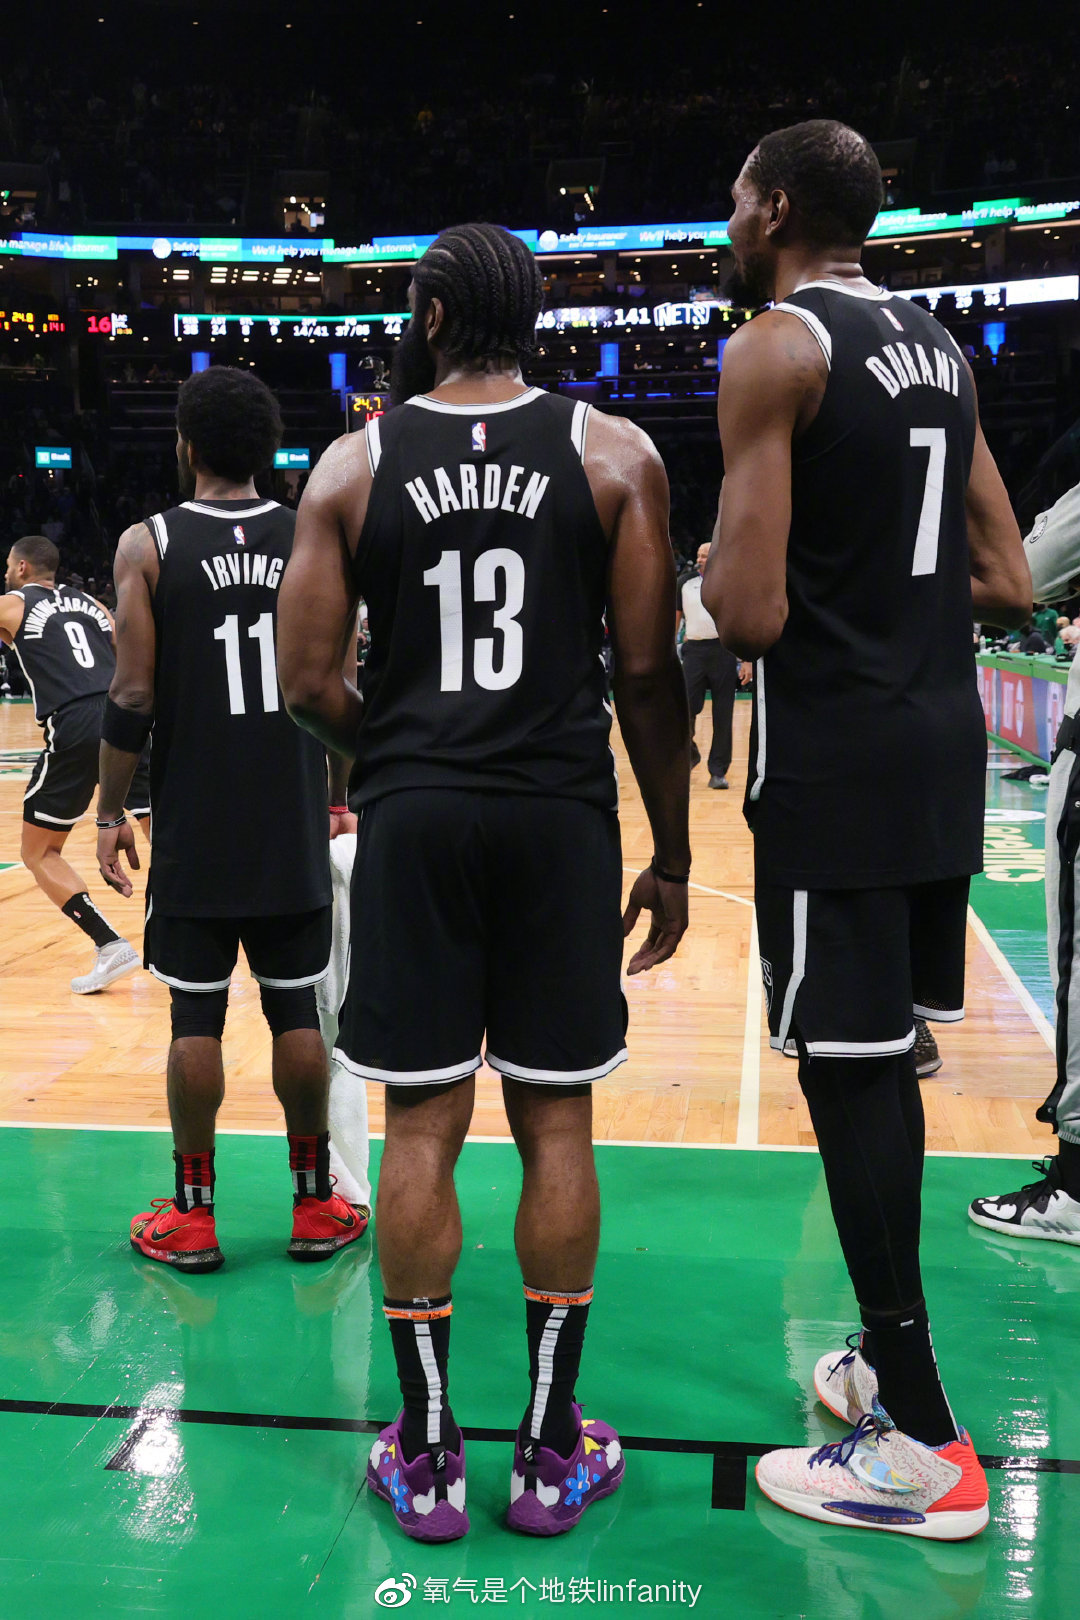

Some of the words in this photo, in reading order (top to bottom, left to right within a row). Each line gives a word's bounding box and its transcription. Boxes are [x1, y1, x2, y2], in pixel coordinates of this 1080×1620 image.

[988, 206, 1013, 219] help
[1013, 204, 1035, 218] you
[664, 229, 688, 242] help
[687, 228, 708, 243] you
[276, 244, 299, 257] help
[299, 246, 318, 258] you
[319, 246, 357, 257] manage
[87, 315, 112, 333] 16
[614, 307, 651, 326] 141
[656, 302, 708, 326] NETS
[293, 325, 330, 337] 14/41
[865, 341, 959, 399] DURANT
[353, 396, 383, 412] 24.7
[404, 463, 550, 525] HARDEN
[909, 427, 947, 577] 7
[200, 552, 284, 591] IRVING
[423, 547, 526, 692] 13
[63, 621, 95, 669] 9
[213, 612, 280, 715] 11
